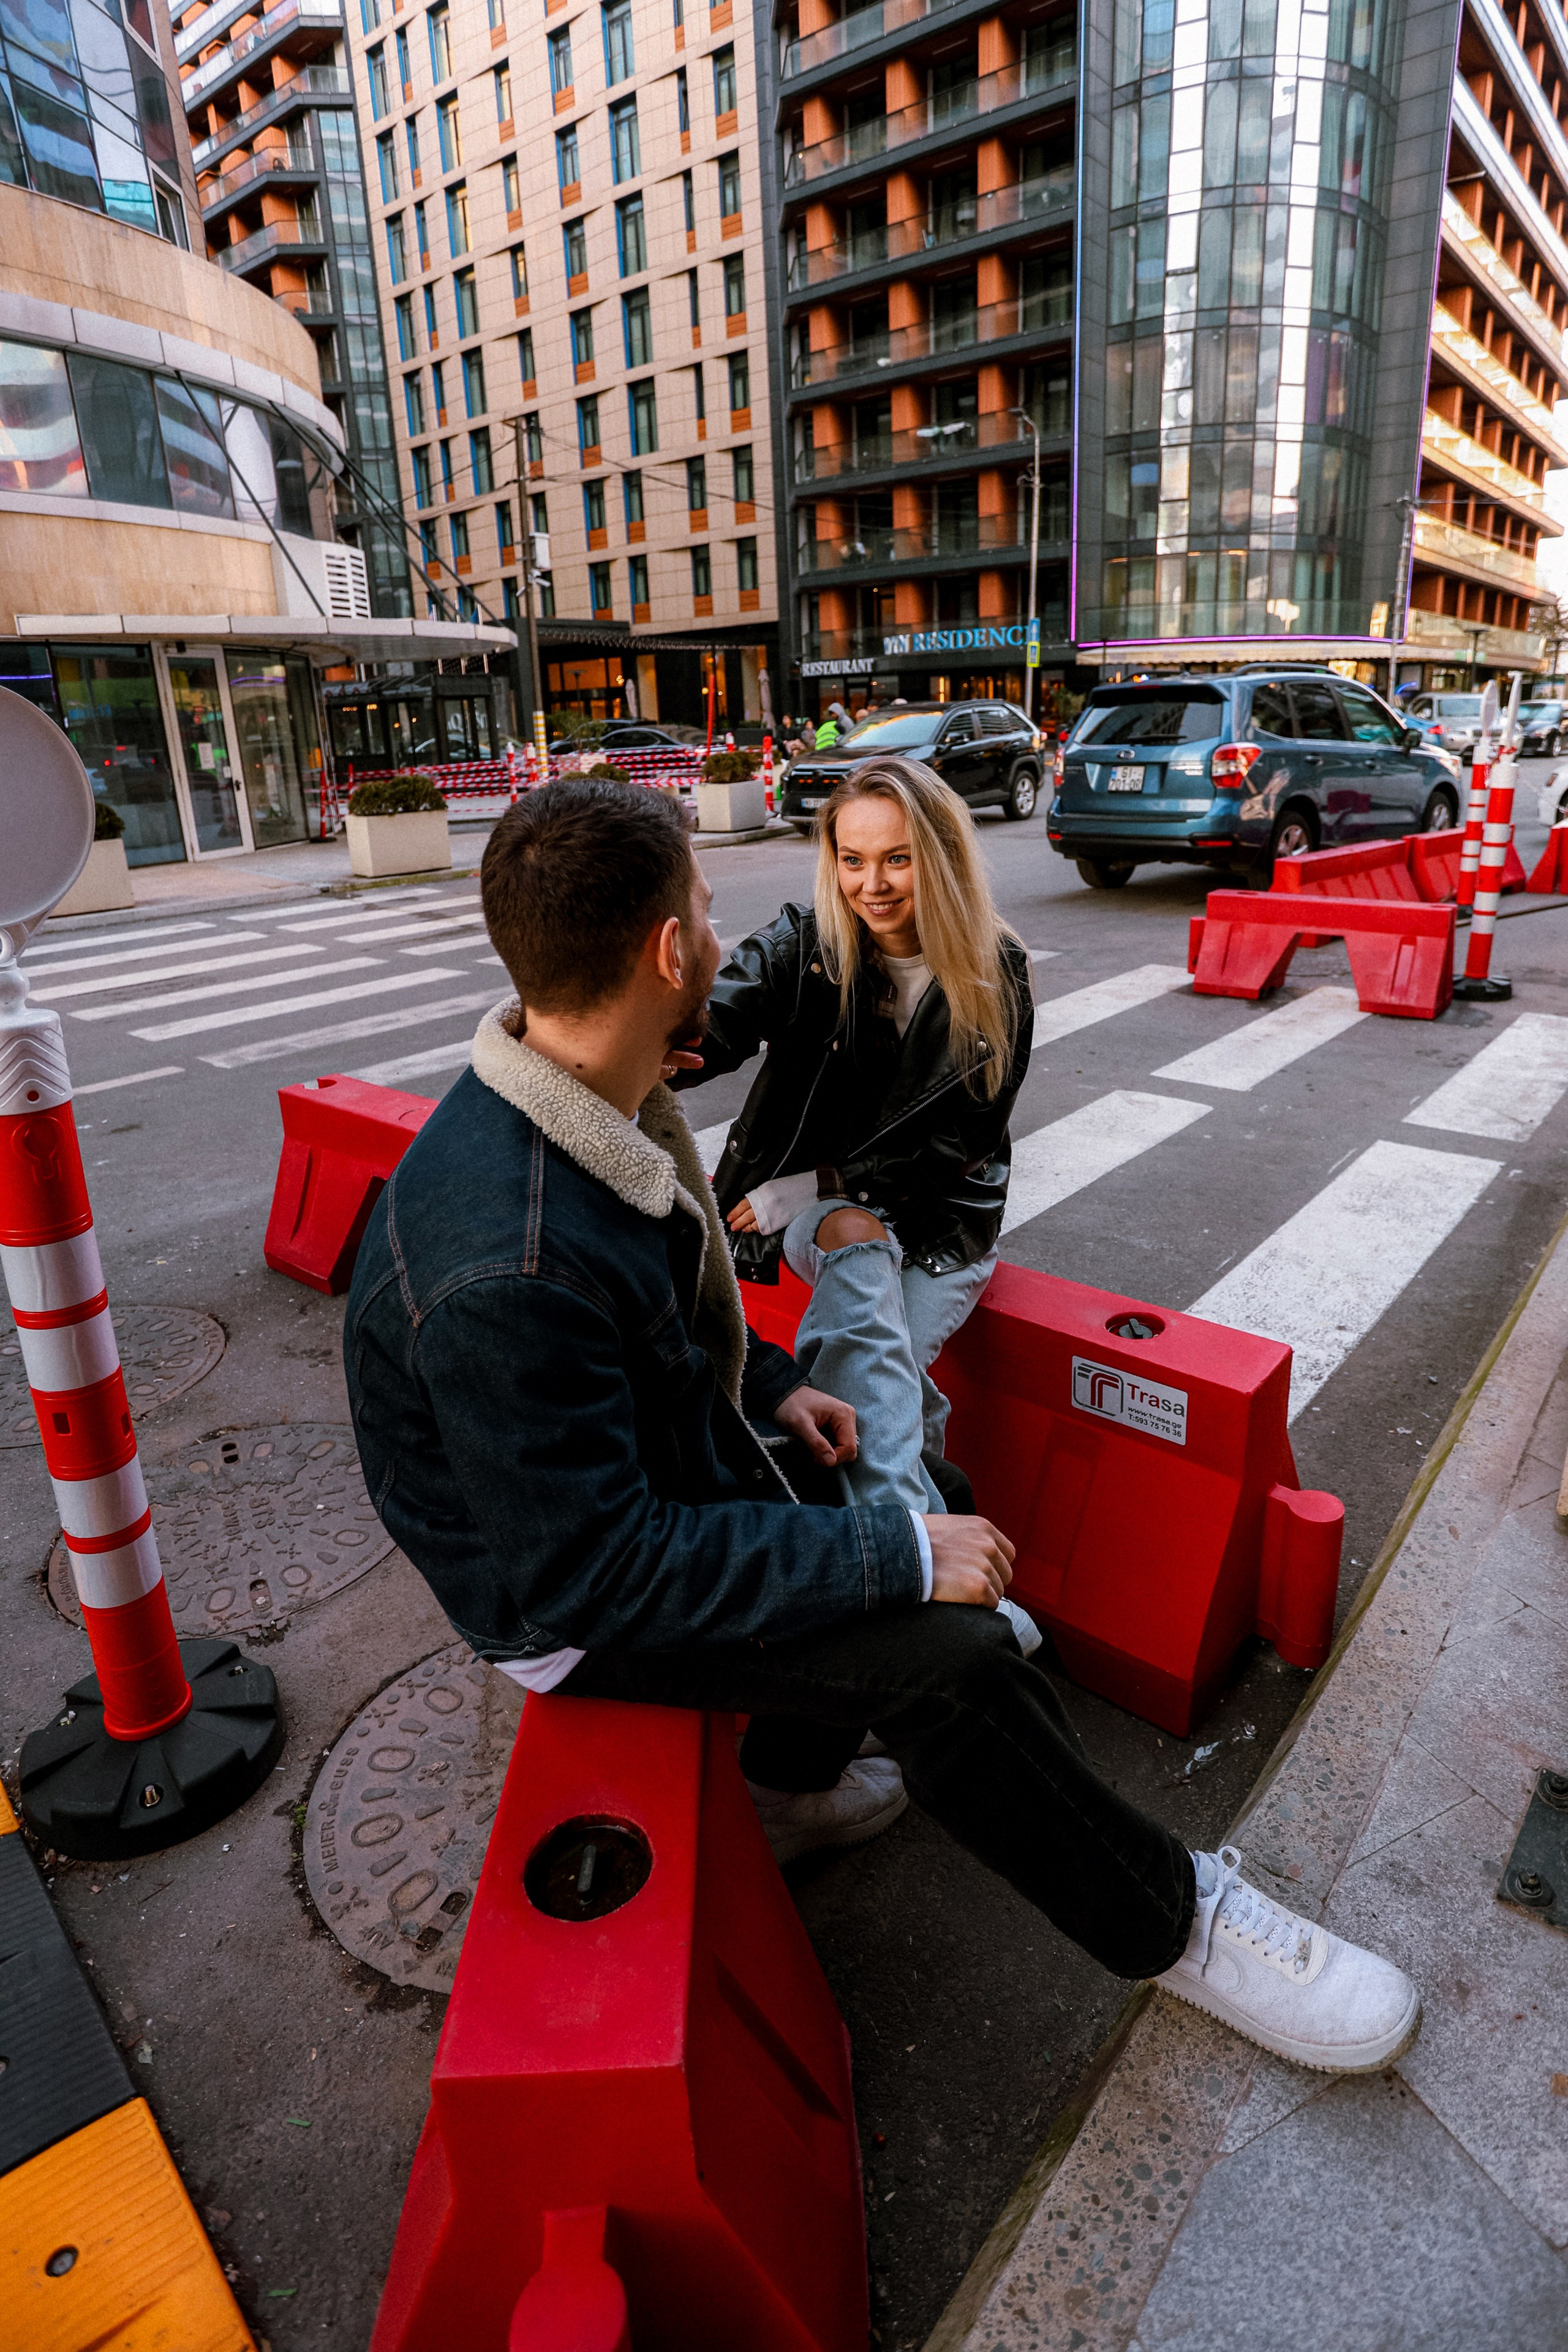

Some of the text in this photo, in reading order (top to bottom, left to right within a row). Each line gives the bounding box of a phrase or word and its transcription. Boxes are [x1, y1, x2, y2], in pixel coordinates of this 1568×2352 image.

[802, 658, 875, 677] RESTAURANT
[1127, 1383, 1185, 1417] Trasa
[1128, 1407, 1182, 1428] www.trasa.ge
[1128, 1414, 1148, 1425] T:593
[320, 1747, 360, 1874] MEIER GUSS
